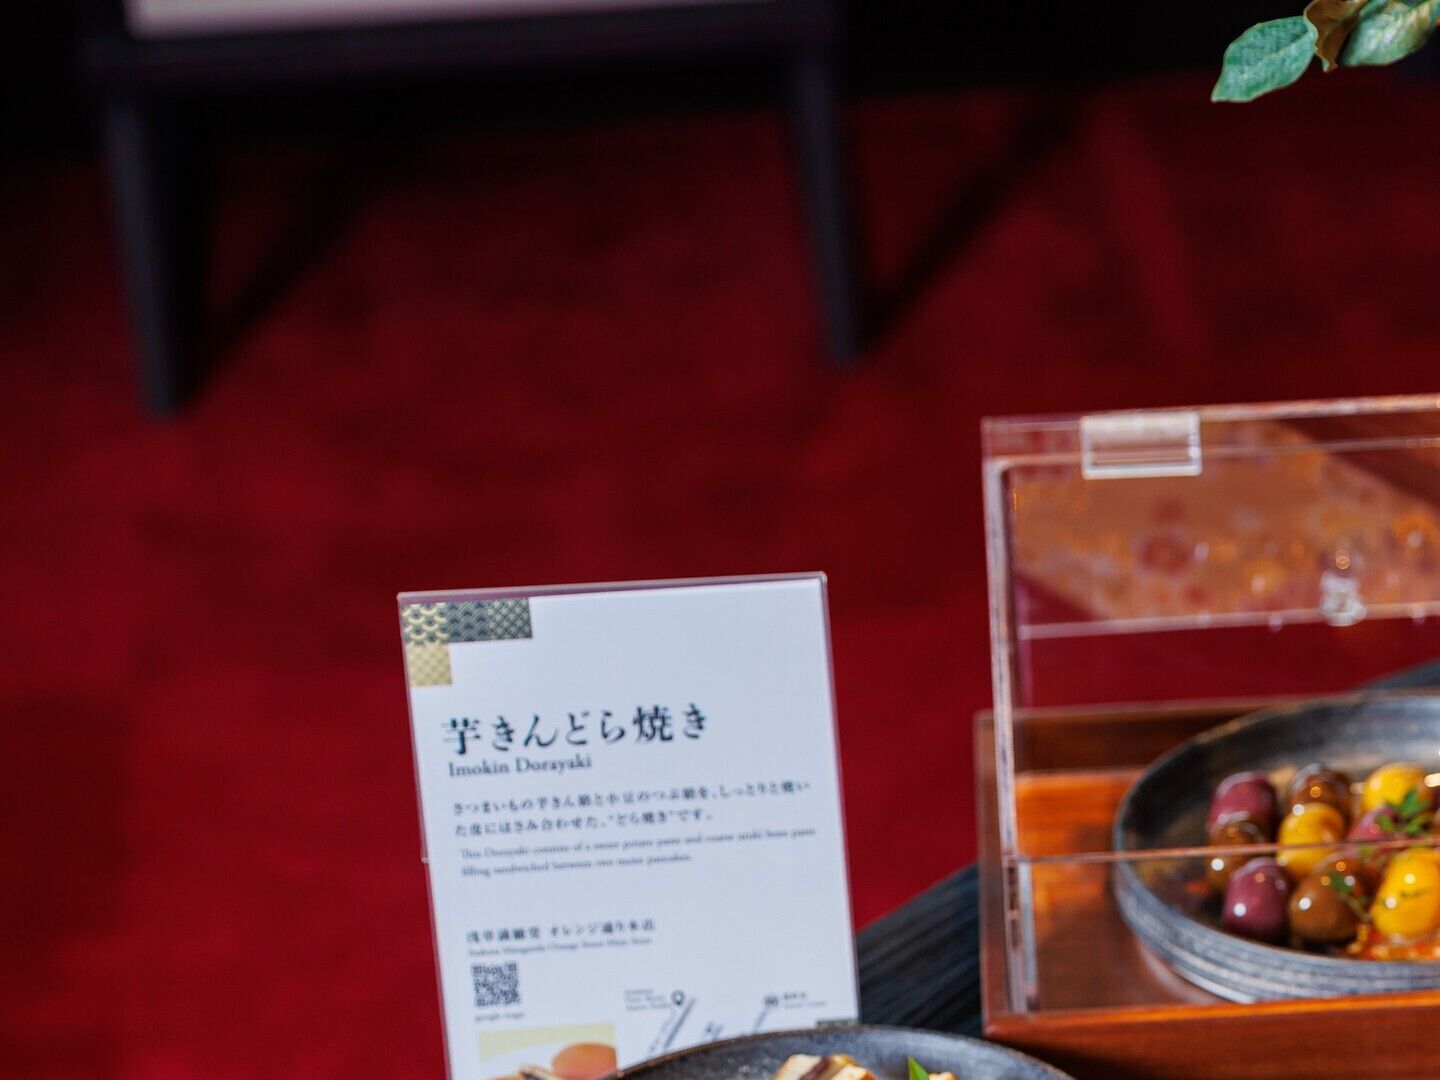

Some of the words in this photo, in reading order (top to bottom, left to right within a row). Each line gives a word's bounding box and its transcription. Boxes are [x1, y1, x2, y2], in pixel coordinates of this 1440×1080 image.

[442, 703, 707, 755] 芋きんどら焼き
[449, 761, 510, 777] Imokin
[516, 754, 592, 775] Dorayaki
